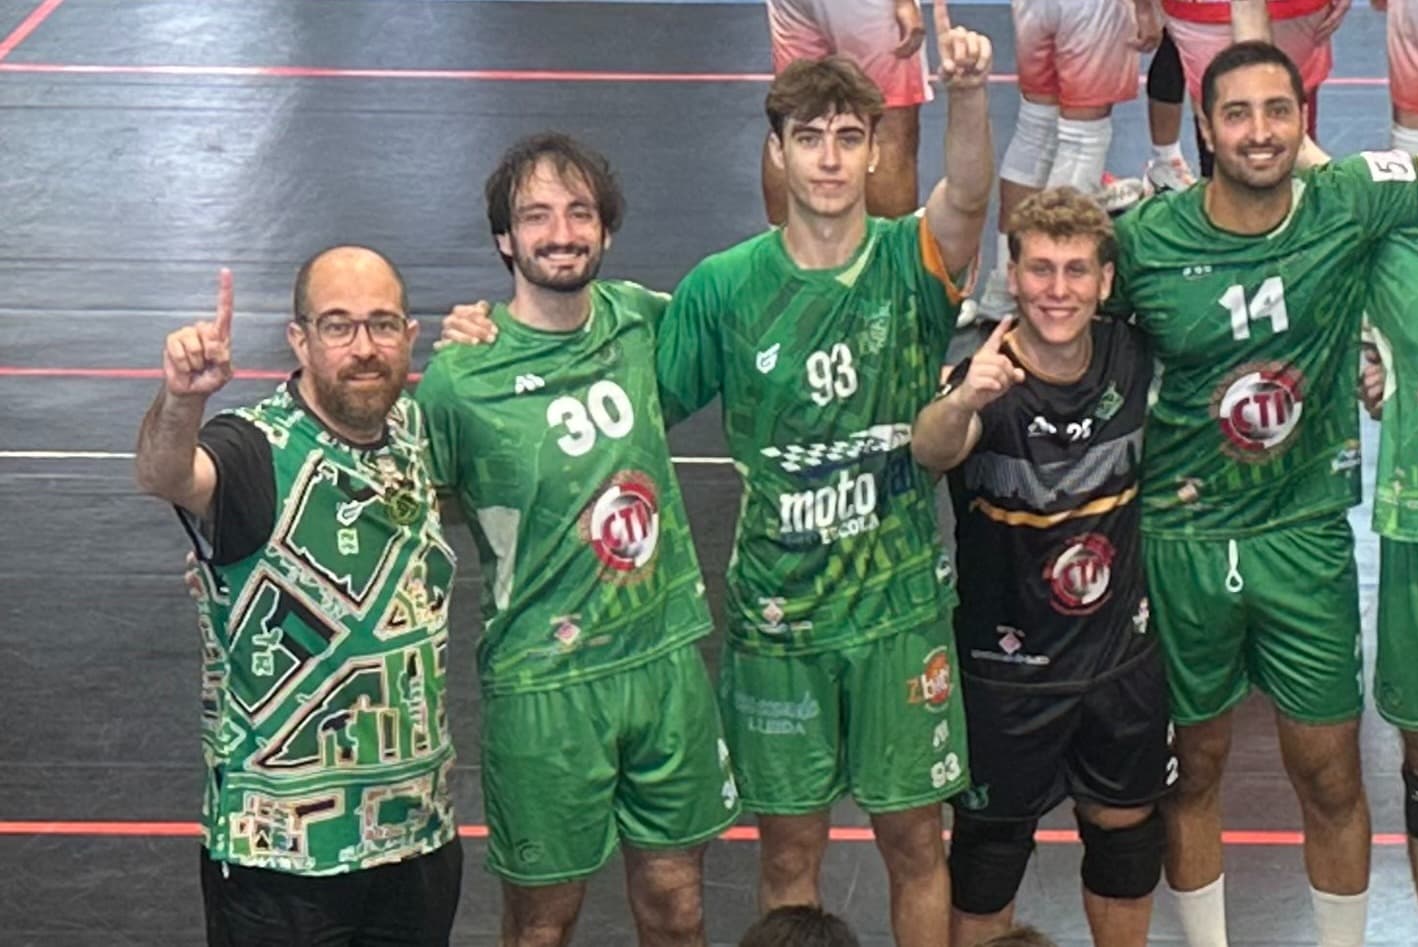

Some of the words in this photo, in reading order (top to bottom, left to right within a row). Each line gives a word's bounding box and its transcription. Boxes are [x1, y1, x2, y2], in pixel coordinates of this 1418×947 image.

[1218, 276, 1289, 341] 14
[806, 342, 858, 406] 93
[546, 380, 634, 457] 30
[1231, 390, 1286, 432] CTI
[601, 500, 649, 549] CTI
[931, 752, 962, 788] 93
